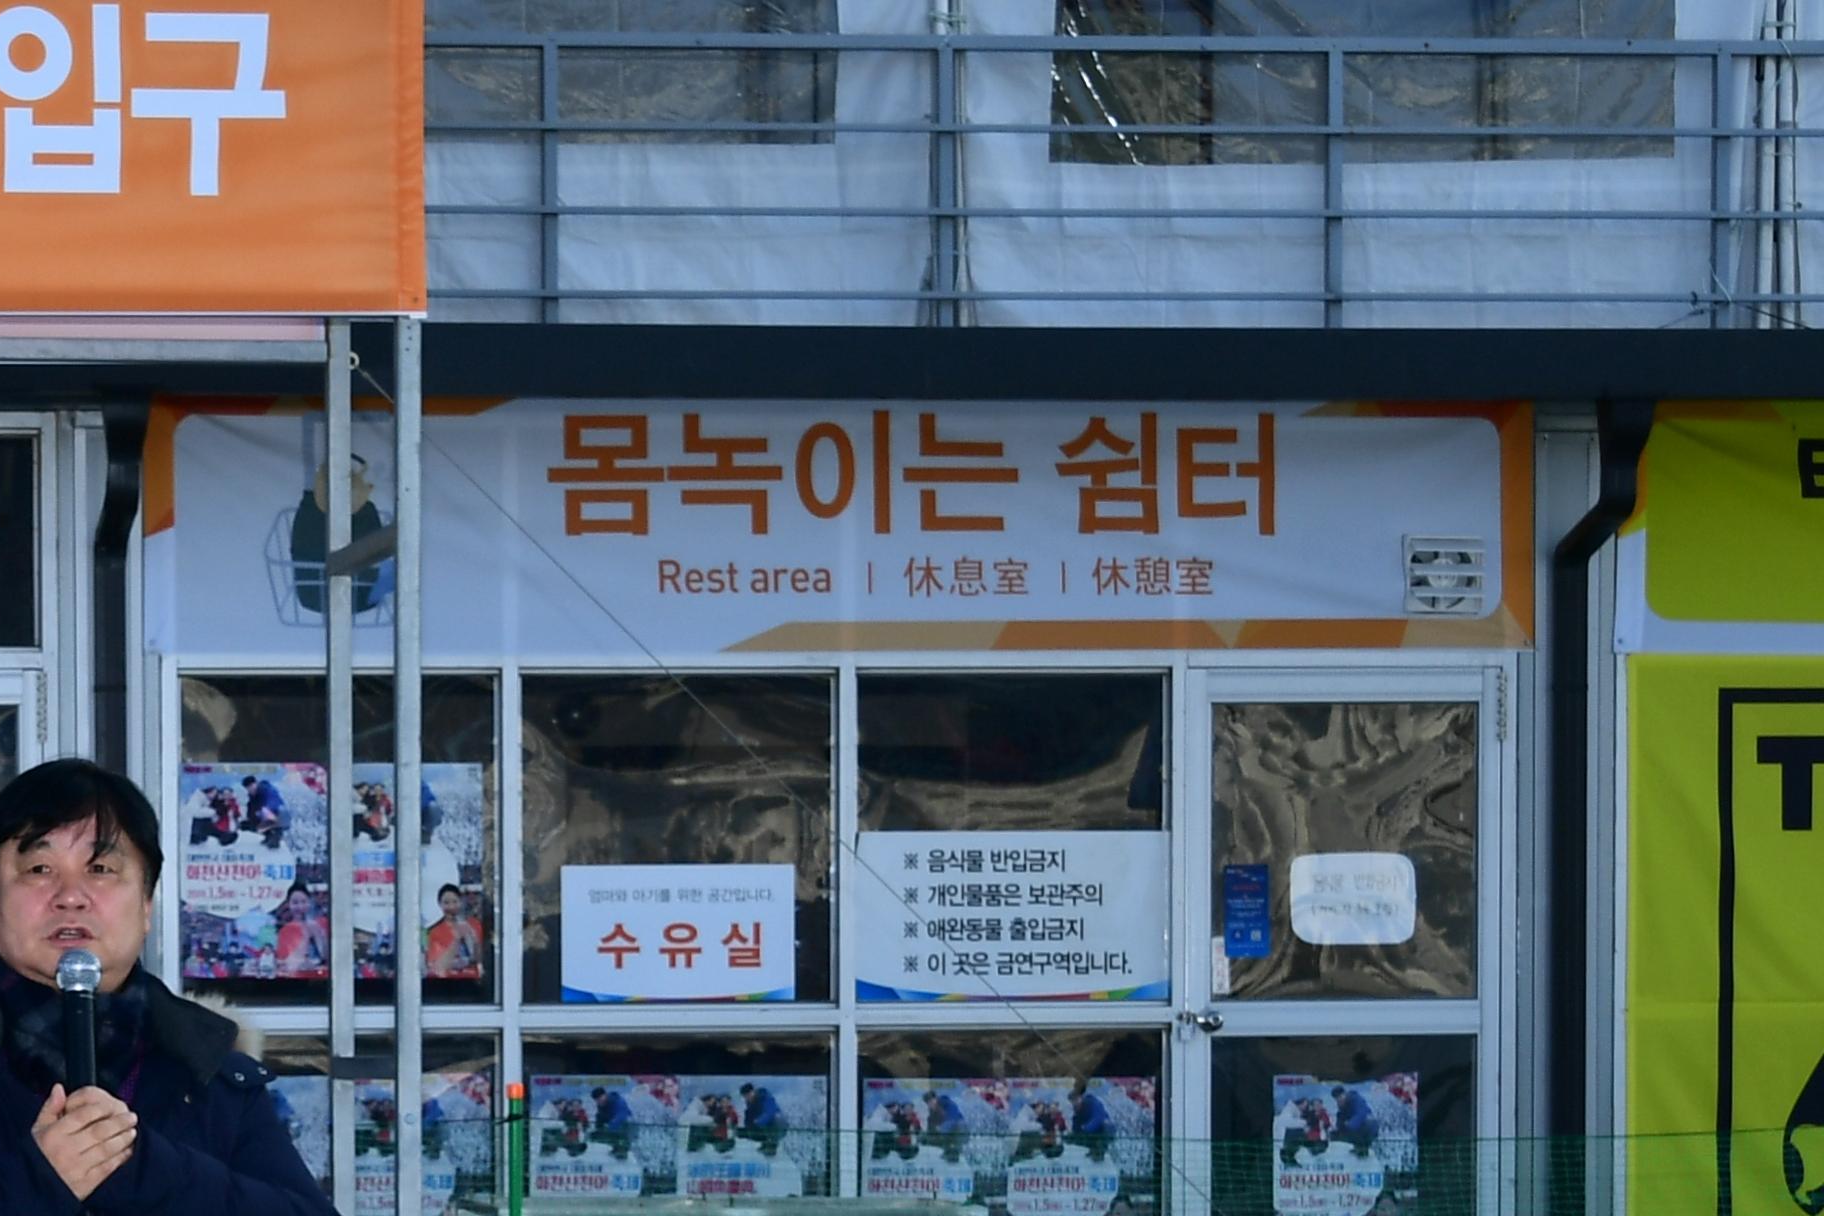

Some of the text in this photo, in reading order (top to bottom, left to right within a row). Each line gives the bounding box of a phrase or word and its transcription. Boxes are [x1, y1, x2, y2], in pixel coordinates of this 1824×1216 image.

[548, 409, 1276, 535] 몸녹이는 쉼터
[659, 556, 1214, 597] Rest area 休息室 休憩室
[927, 849, 984, 873] 음식물
[991, 849, 1066, 873] 반입금지
[677, 888, 703, 904] 위한
[928, 883, 1023, 907] 개인물품은
[1028, 883, 1103, 907] 보관주의
[927, 918, 1003, 942] 애완동물
[1010, 917, 1084, 941] 출입금지
[928, 953, 946, 976] 이
[952, 951, 990, 976] 곳은
[996, 951, 1133, 976] 금연구역입니다.
